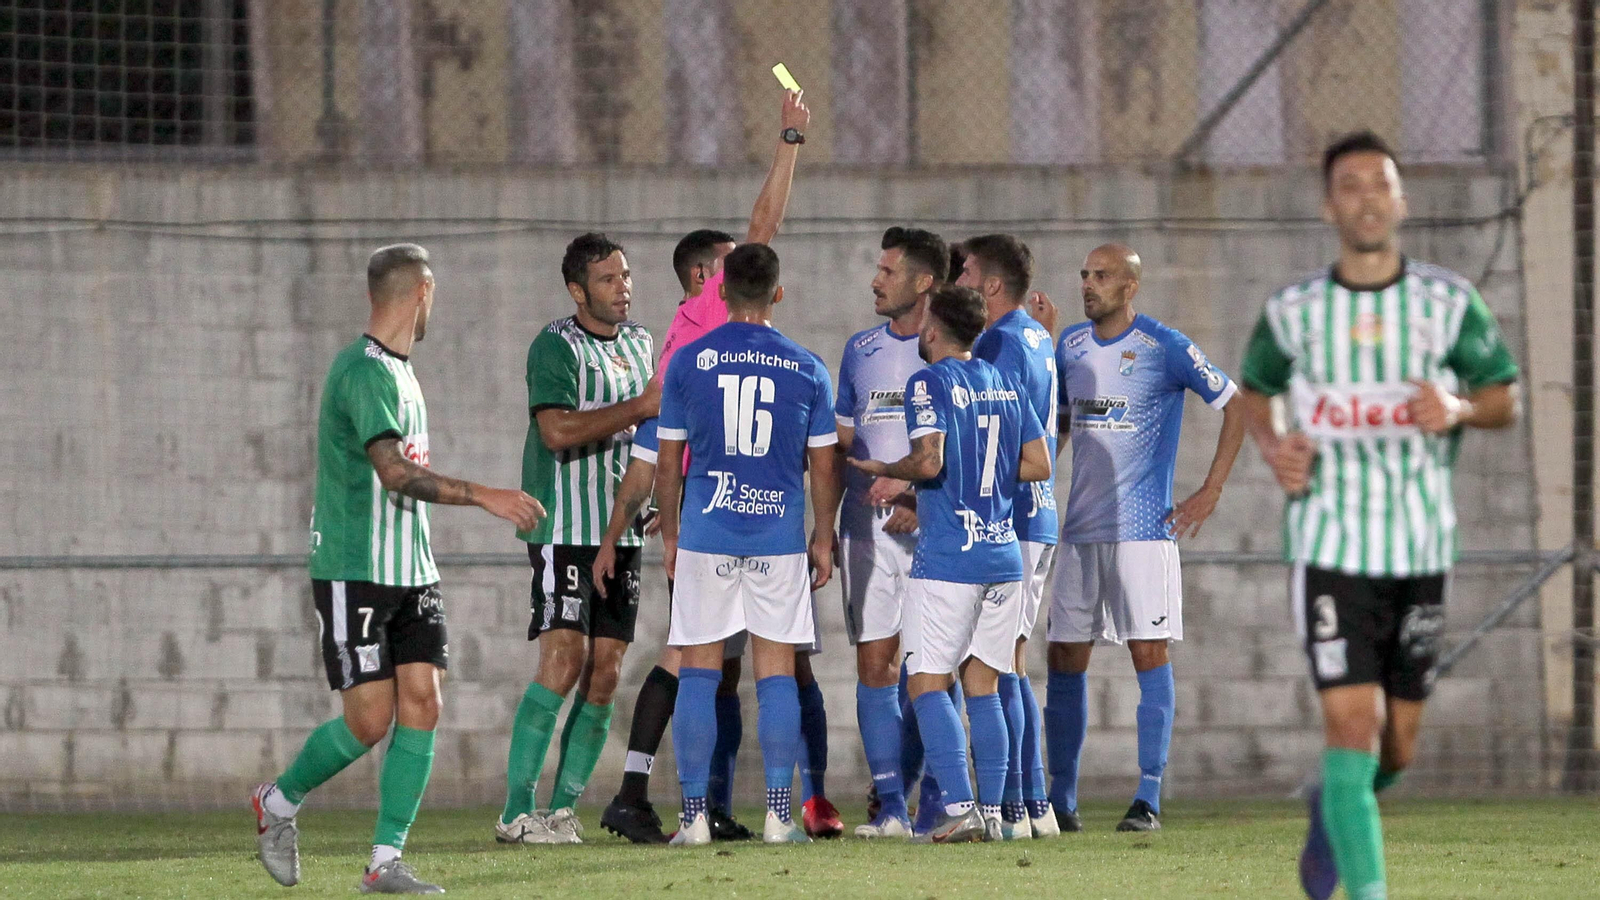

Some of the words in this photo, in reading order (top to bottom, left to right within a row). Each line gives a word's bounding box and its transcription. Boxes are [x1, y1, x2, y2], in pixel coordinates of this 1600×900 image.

[721, 350, 799, 372] duokitchen
[718, 374, 775, 457] 16
[977, 414, 1000, 497] 7
[740, 484, 784, 502] Soccer
[720, 496, 786, 518] Academy
[566, 564, 579, 591] 9
[357, 607, 374, 638] 7
